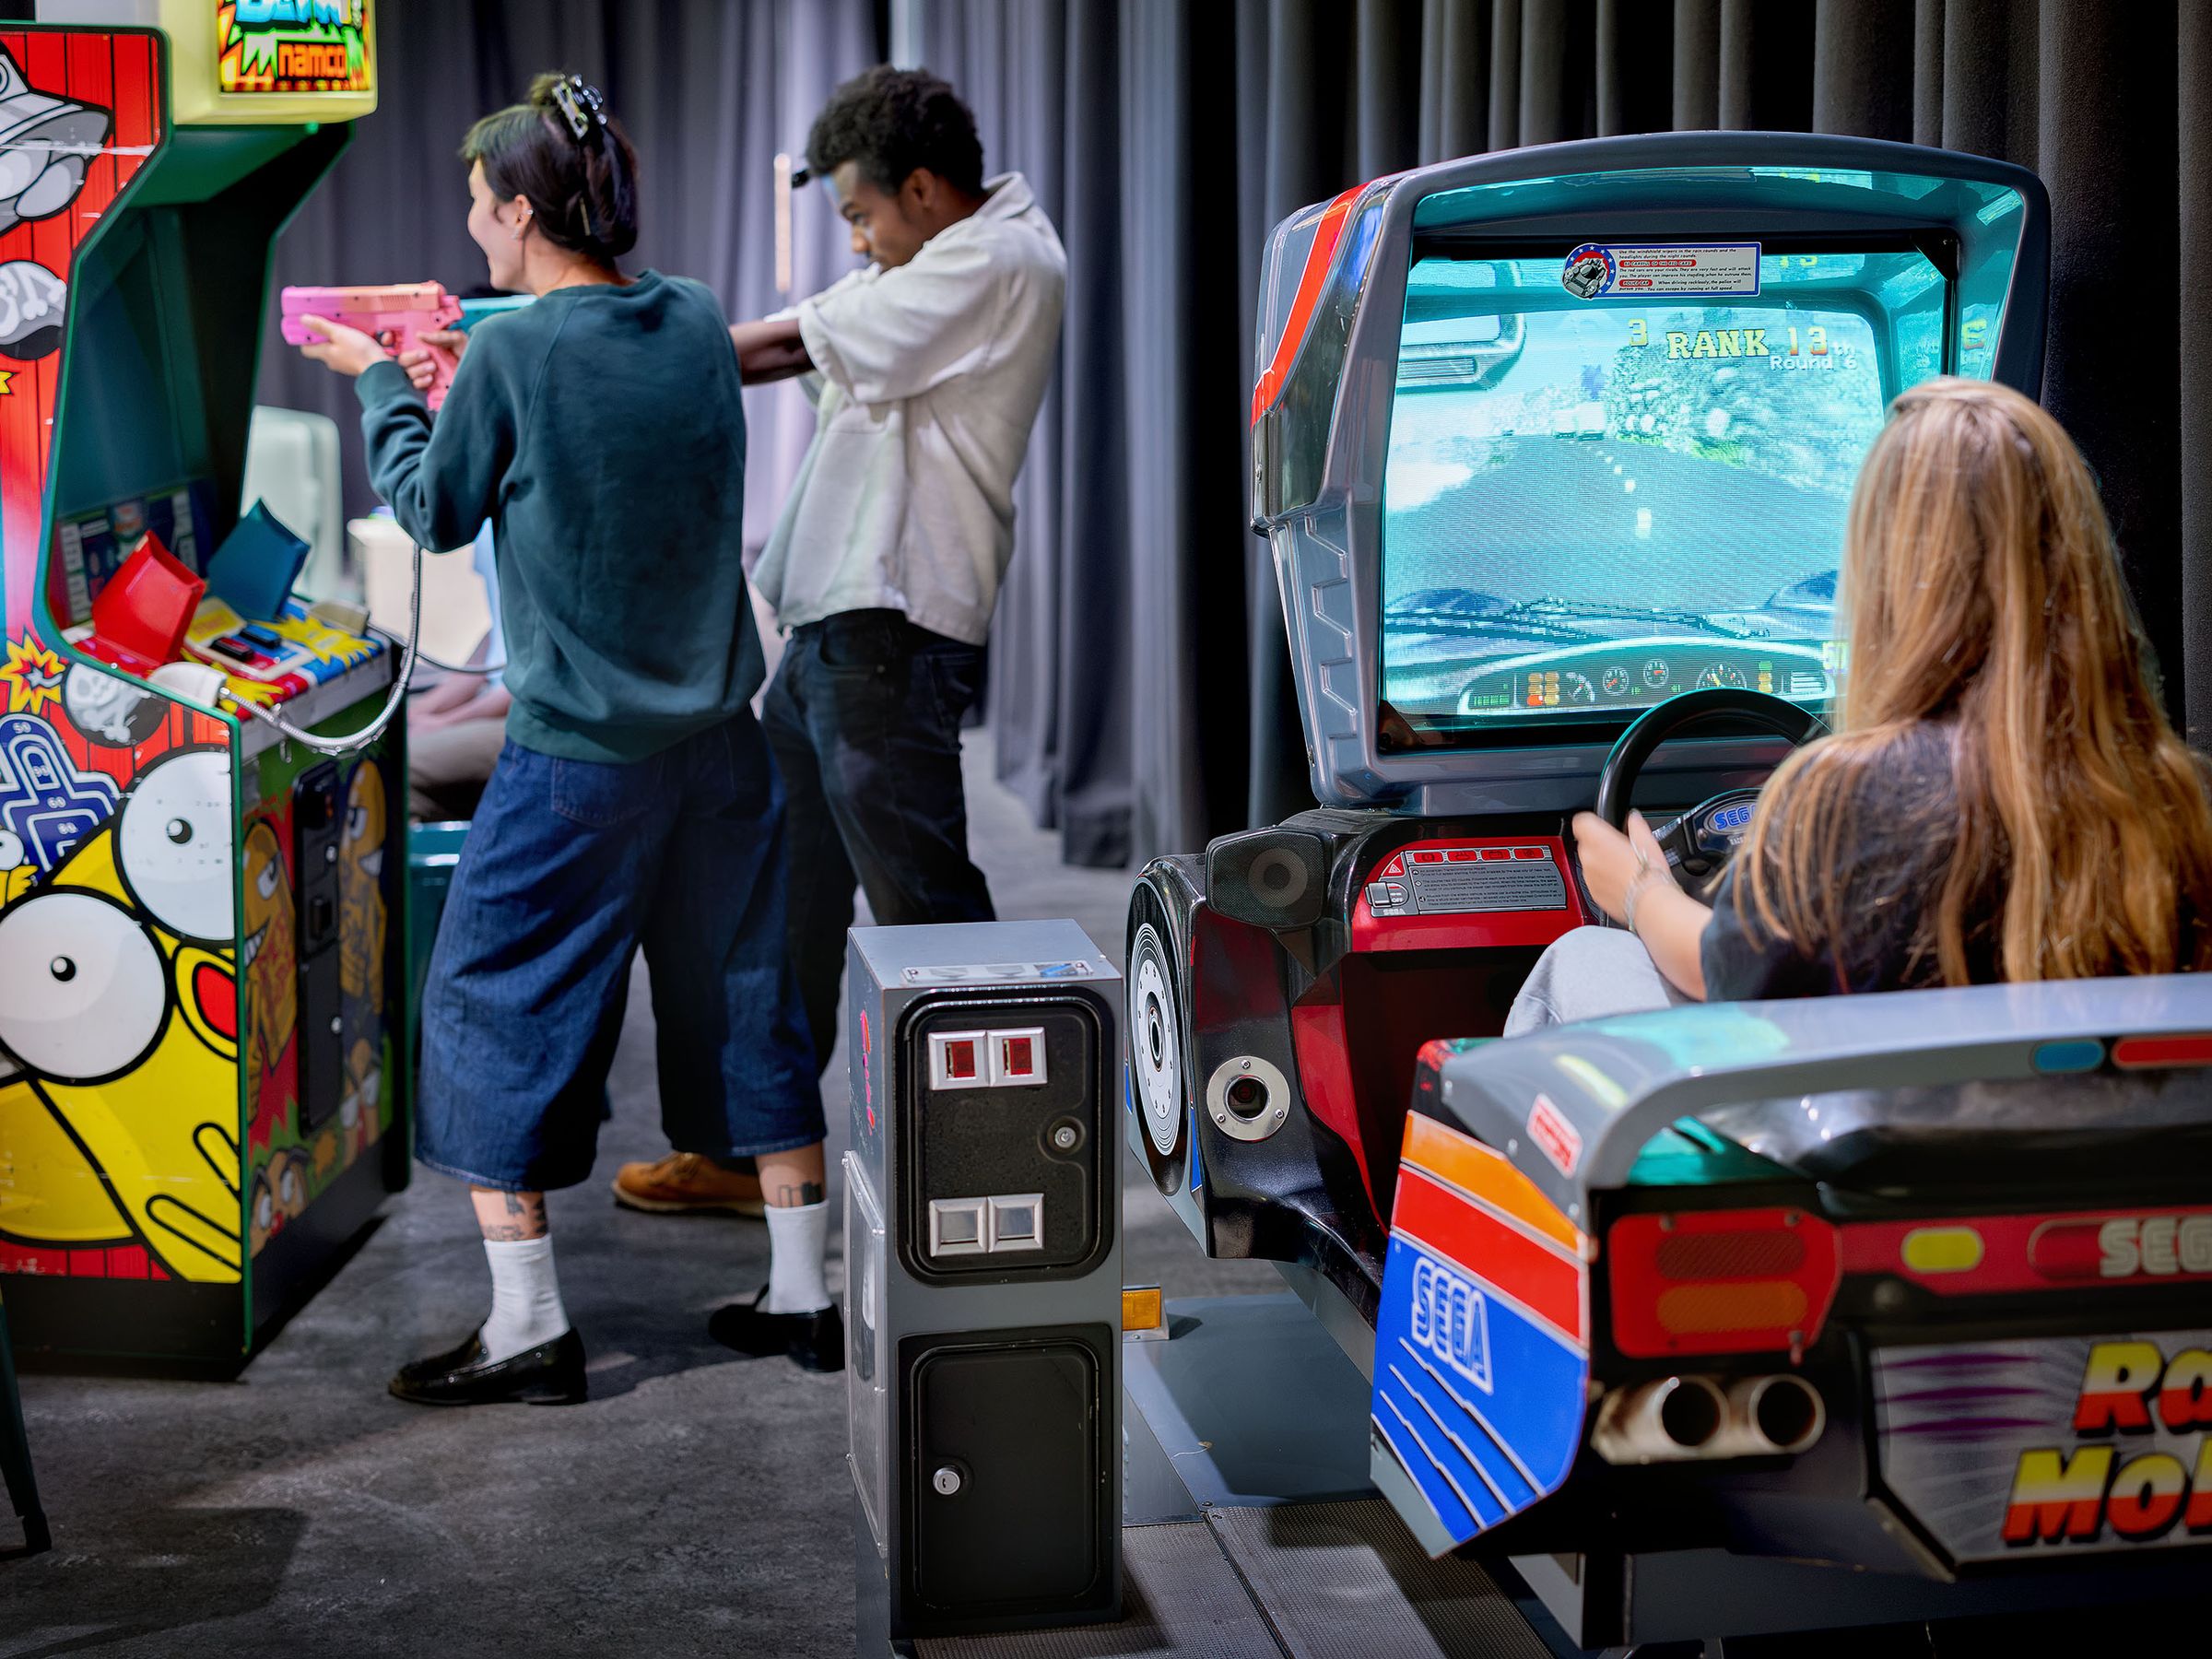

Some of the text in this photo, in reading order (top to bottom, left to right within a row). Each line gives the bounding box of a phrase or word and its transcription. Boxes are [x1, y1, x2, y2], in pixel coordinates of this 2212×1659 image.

[277, 43, 347, 77] namco
[1665, 329, 1770, 359] RANK
[1771, 355, 1858, 371] Round 6
[1714, 804, 1757, 830] SEG
[1411, 1256, 1494, 1395] SEGA
